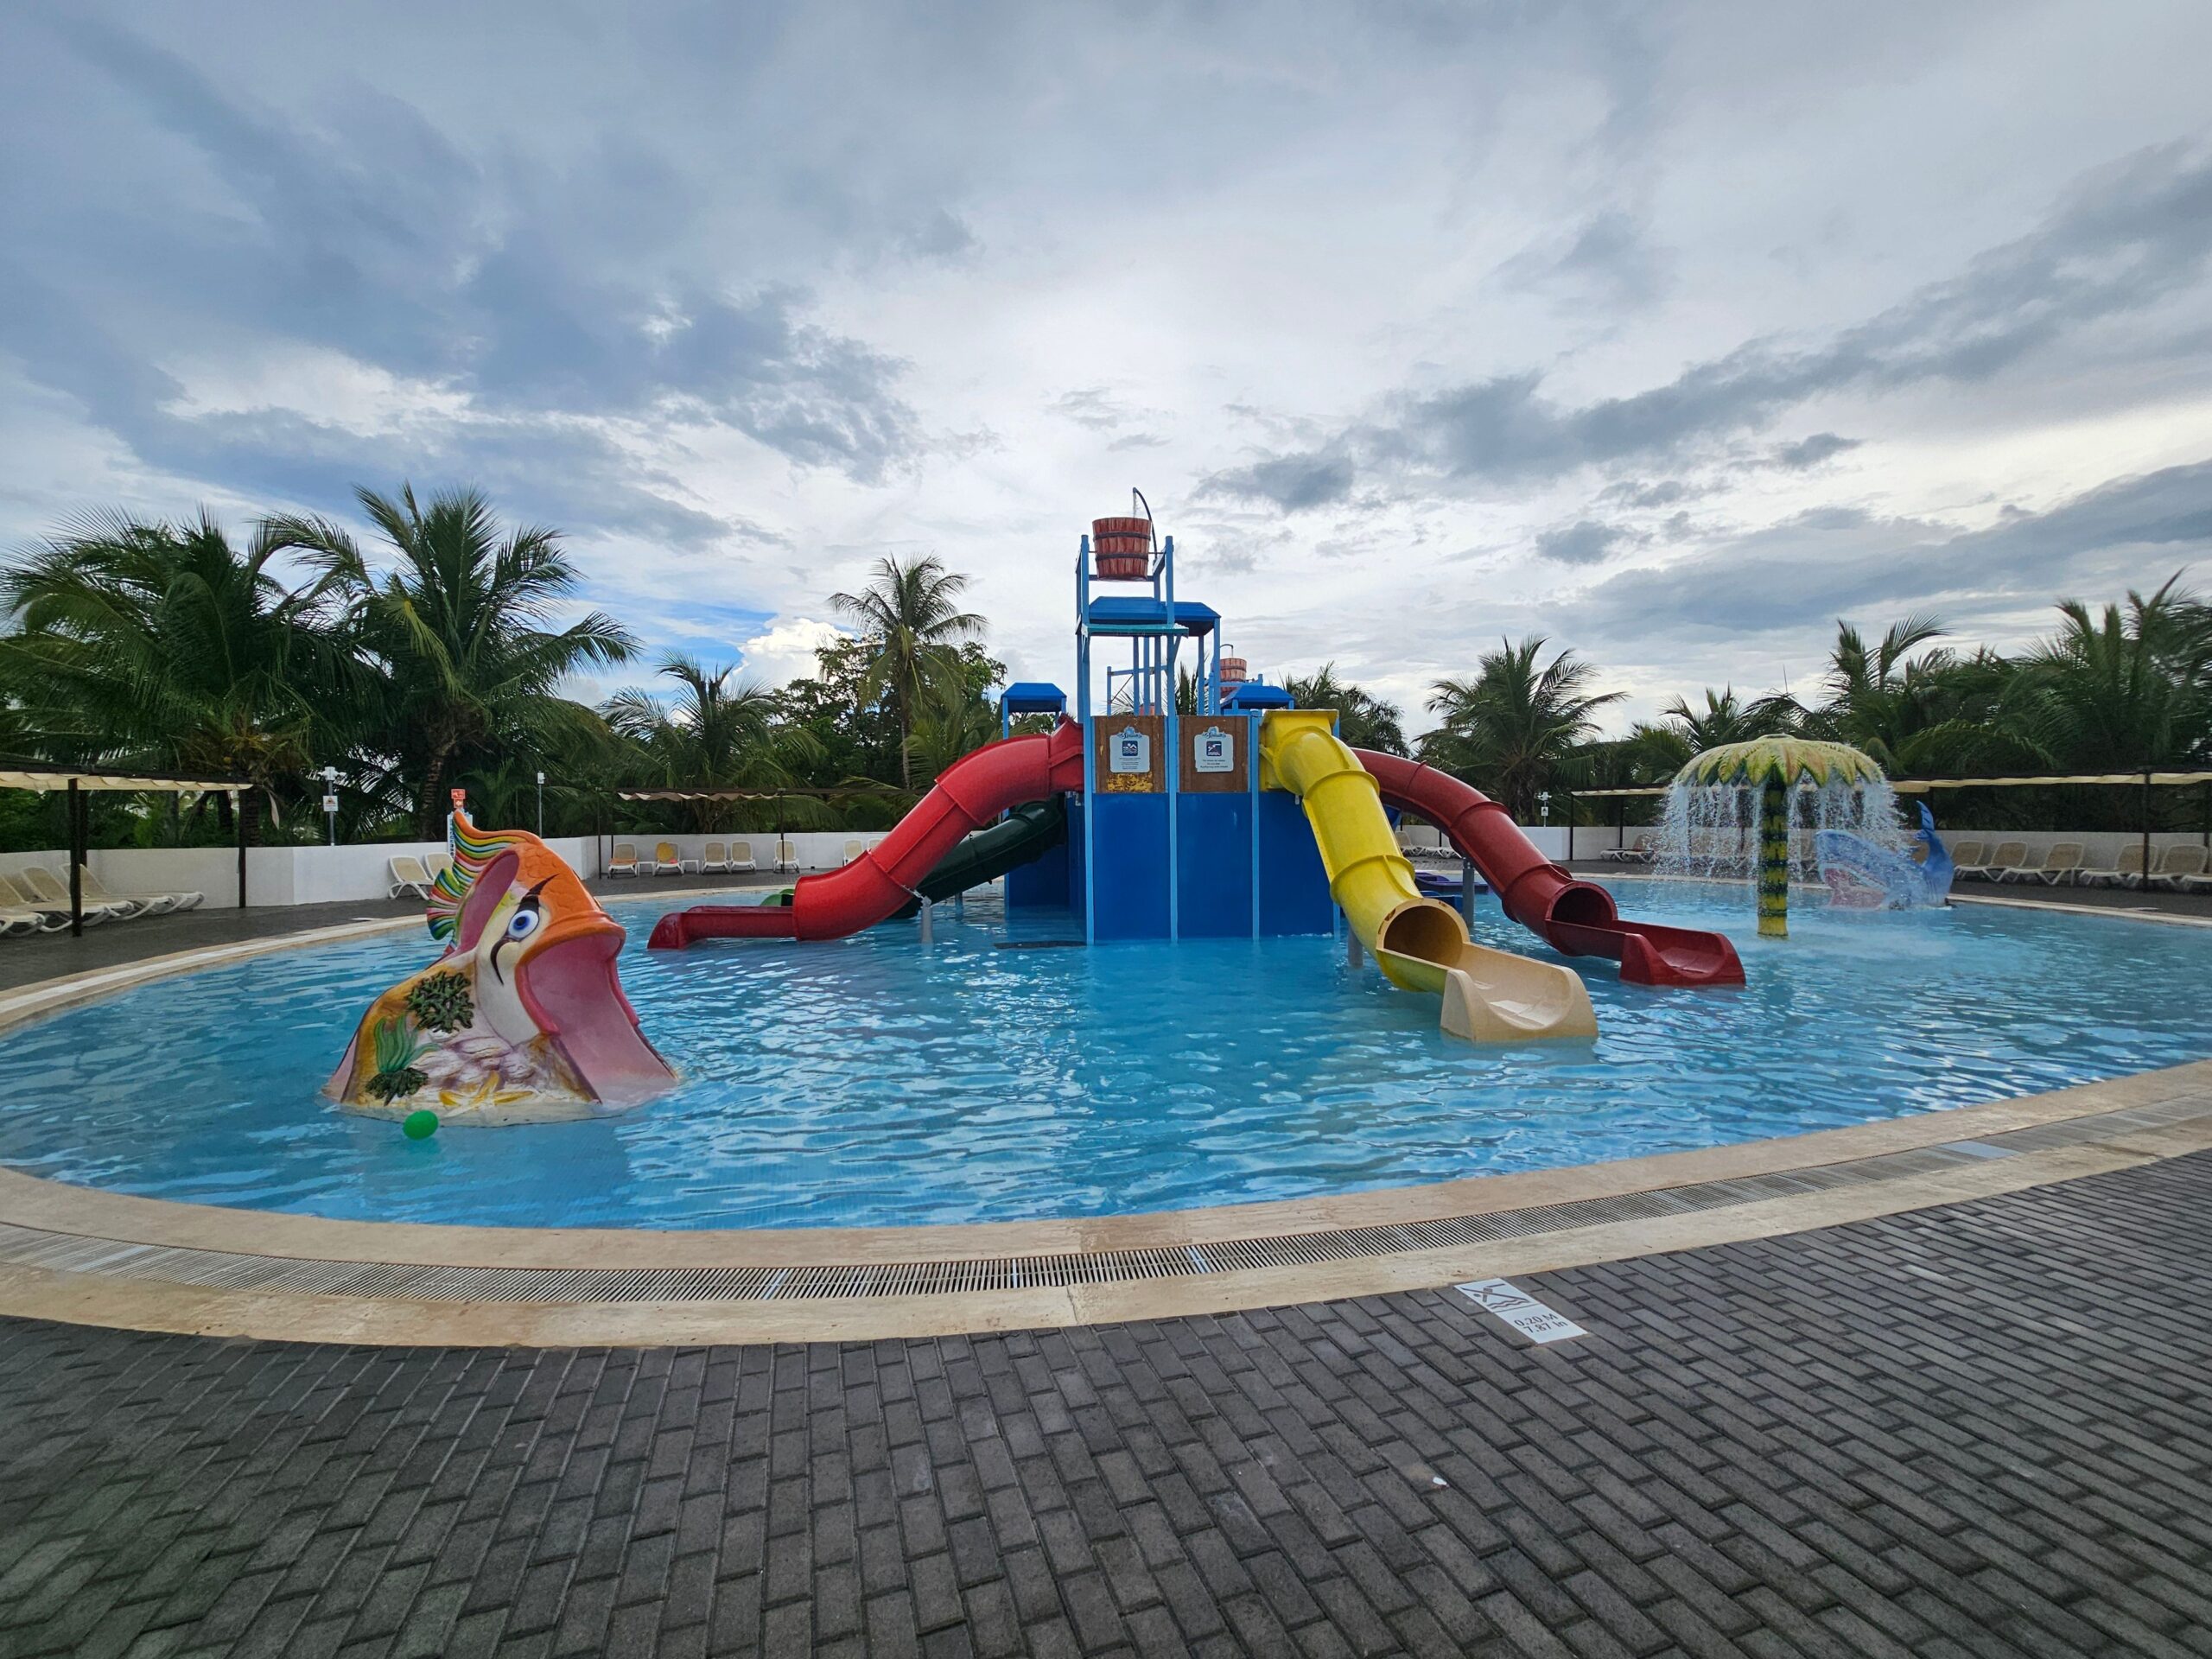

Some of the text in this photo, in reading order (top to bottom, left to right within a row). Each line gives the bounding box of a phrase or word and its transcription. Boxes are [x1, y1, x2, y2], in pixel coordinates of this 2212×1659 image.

[1514, 1313, 1559, 1326] 0.20 M
[1523, 1322, 1552, 1333] 7.87
